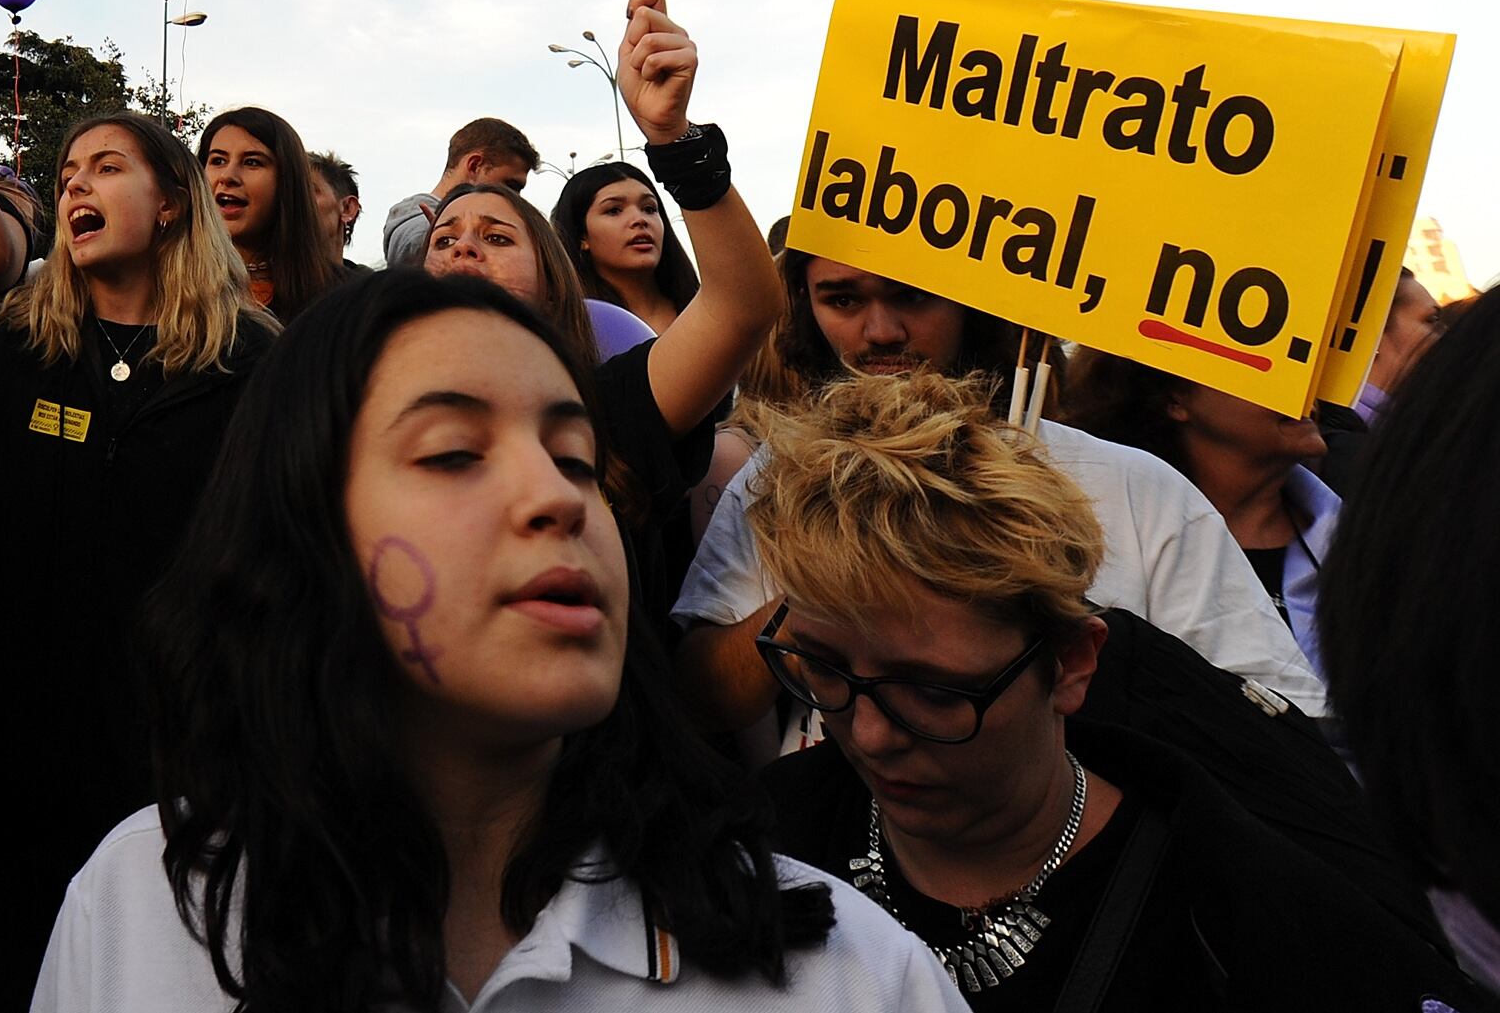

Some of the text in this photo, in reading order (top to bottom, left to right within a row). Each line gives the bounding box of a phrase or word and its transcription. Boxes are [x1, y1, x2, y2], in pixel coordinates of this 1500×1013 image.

[882, 14, 1274, 175] Maltrato
[800, 130, 1107, 313] laboral,
[1145, 242, 1313, 363] no.
